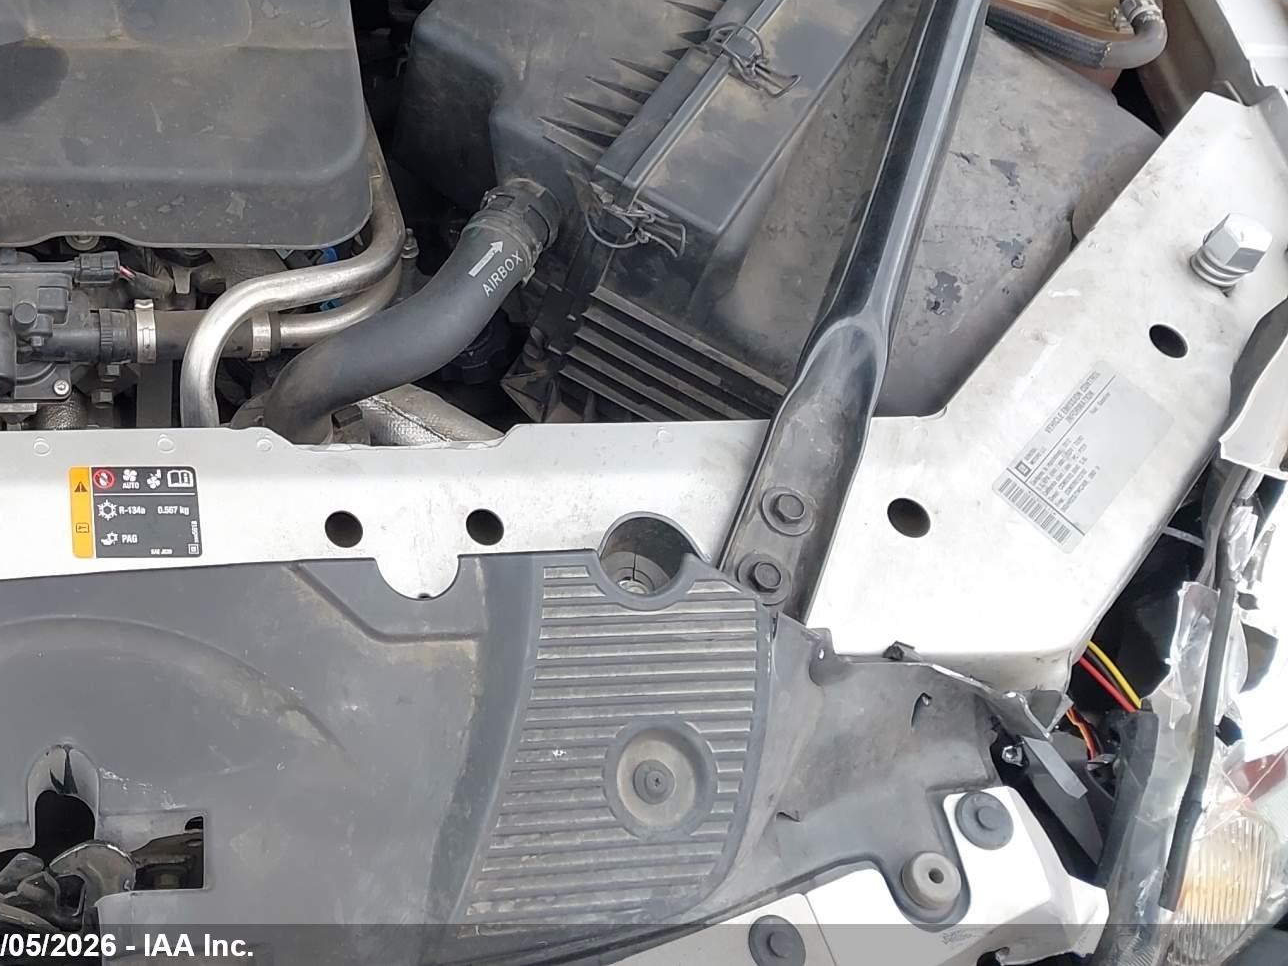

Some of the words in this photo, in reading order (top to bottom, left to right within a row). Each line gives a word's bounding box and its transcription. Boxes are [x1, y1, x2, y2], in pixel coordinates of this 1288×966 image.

[482, 250, 524, 298] AIRBOX
[122, 481, 140, 489] AUTO
[118, 505, 146, 515] R-134a
[179, 505, 190, 516] kg
[121, 534, 138, 544] PAG
